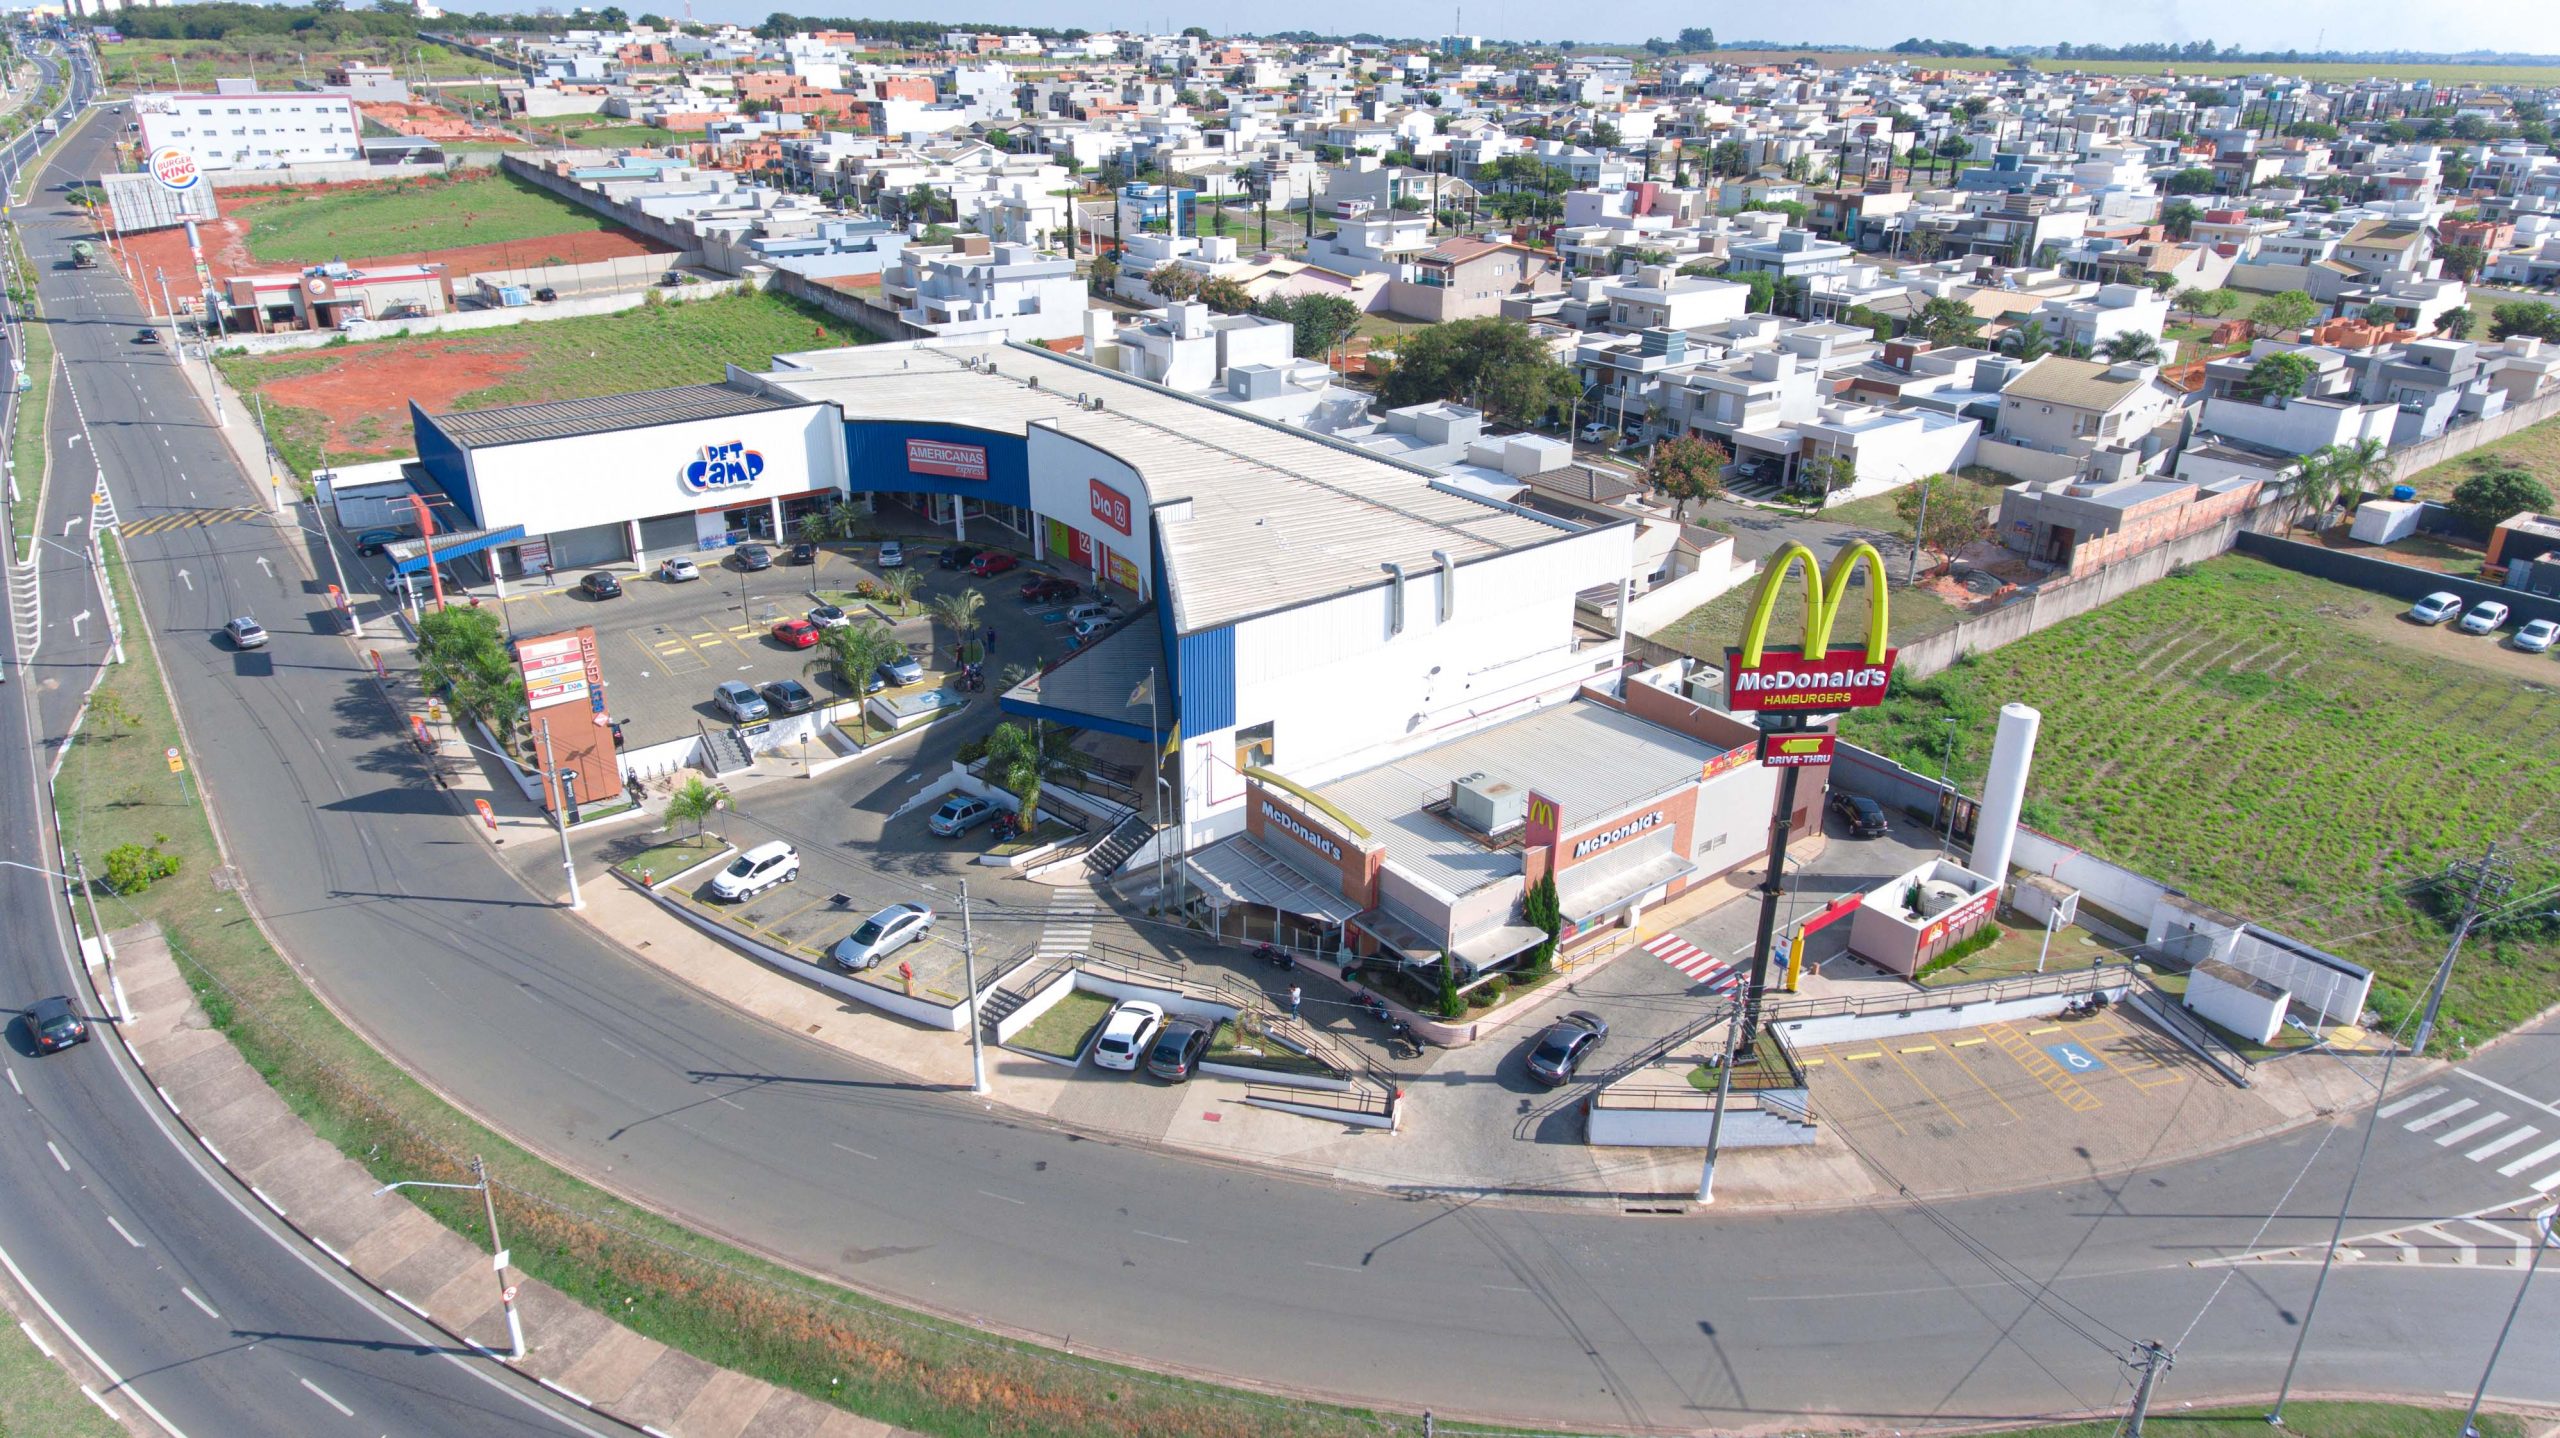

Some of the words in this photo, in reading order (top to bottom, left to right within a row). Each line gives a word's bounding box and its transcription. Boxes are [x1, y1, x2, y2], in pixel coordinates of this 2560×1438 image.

[157, 156, 192, 170] BURGER
[160, 163, 195, 181] KING
[707, 441, 744, 462] PET
[910, 446, 984, 465] AMERICANAS
[956, 465, 985, 478] express
[582, 636, 600, 684] CENTER
[1735, 668, 1886, 692] McDonald's
[590, 683, 605, 713] BEST
[1764, 693, 1852, 705] HAMBURGERS
[1767, 754, 1831, 765] DRIVE-THRU
[1262, 800, 1342, 861] McDonald's
[1574, 811, 1664, 858] McDonald's
